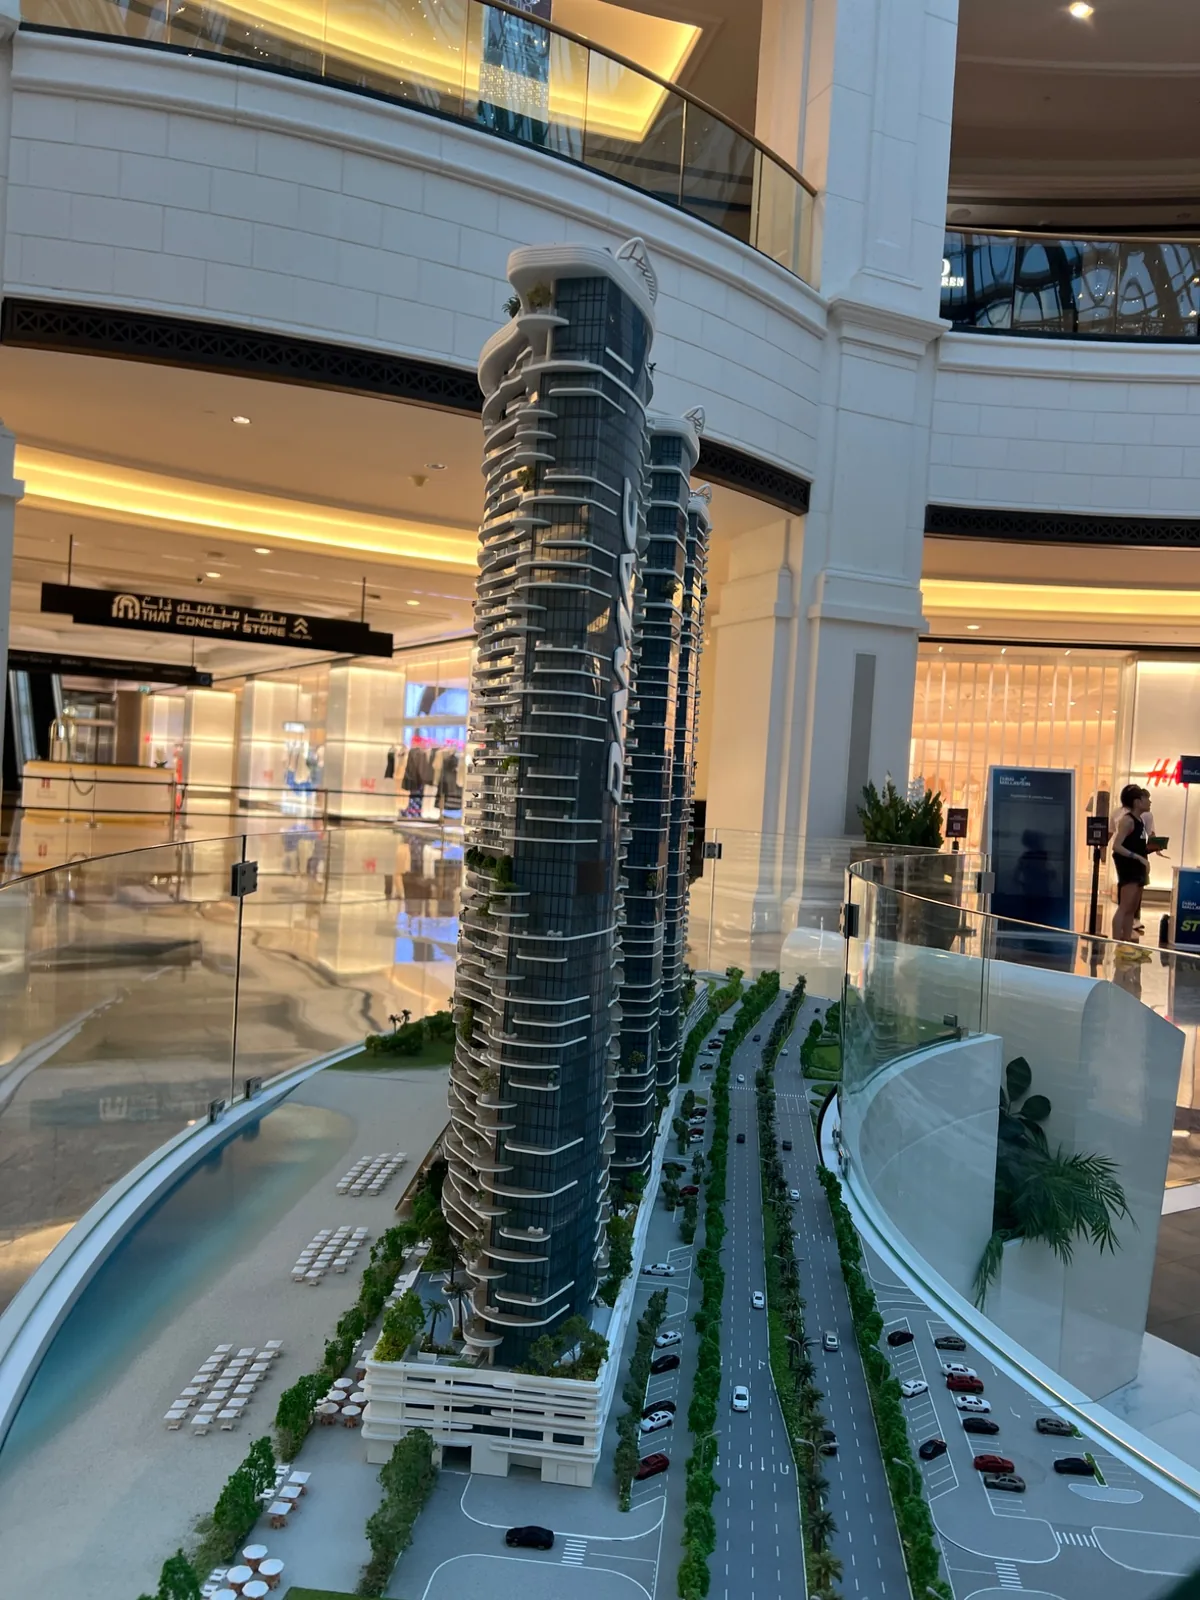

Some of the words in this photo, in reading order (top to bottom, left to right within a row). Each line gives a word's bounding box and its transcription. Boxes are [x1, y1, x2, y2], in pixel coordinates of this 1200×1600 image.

[142, 609, 172, 624] THAT
[176, 615, 240, 632] CONCEPT
[242, 623, 286, 638] STORE
[607, 477, 638, 805] DAMAC
